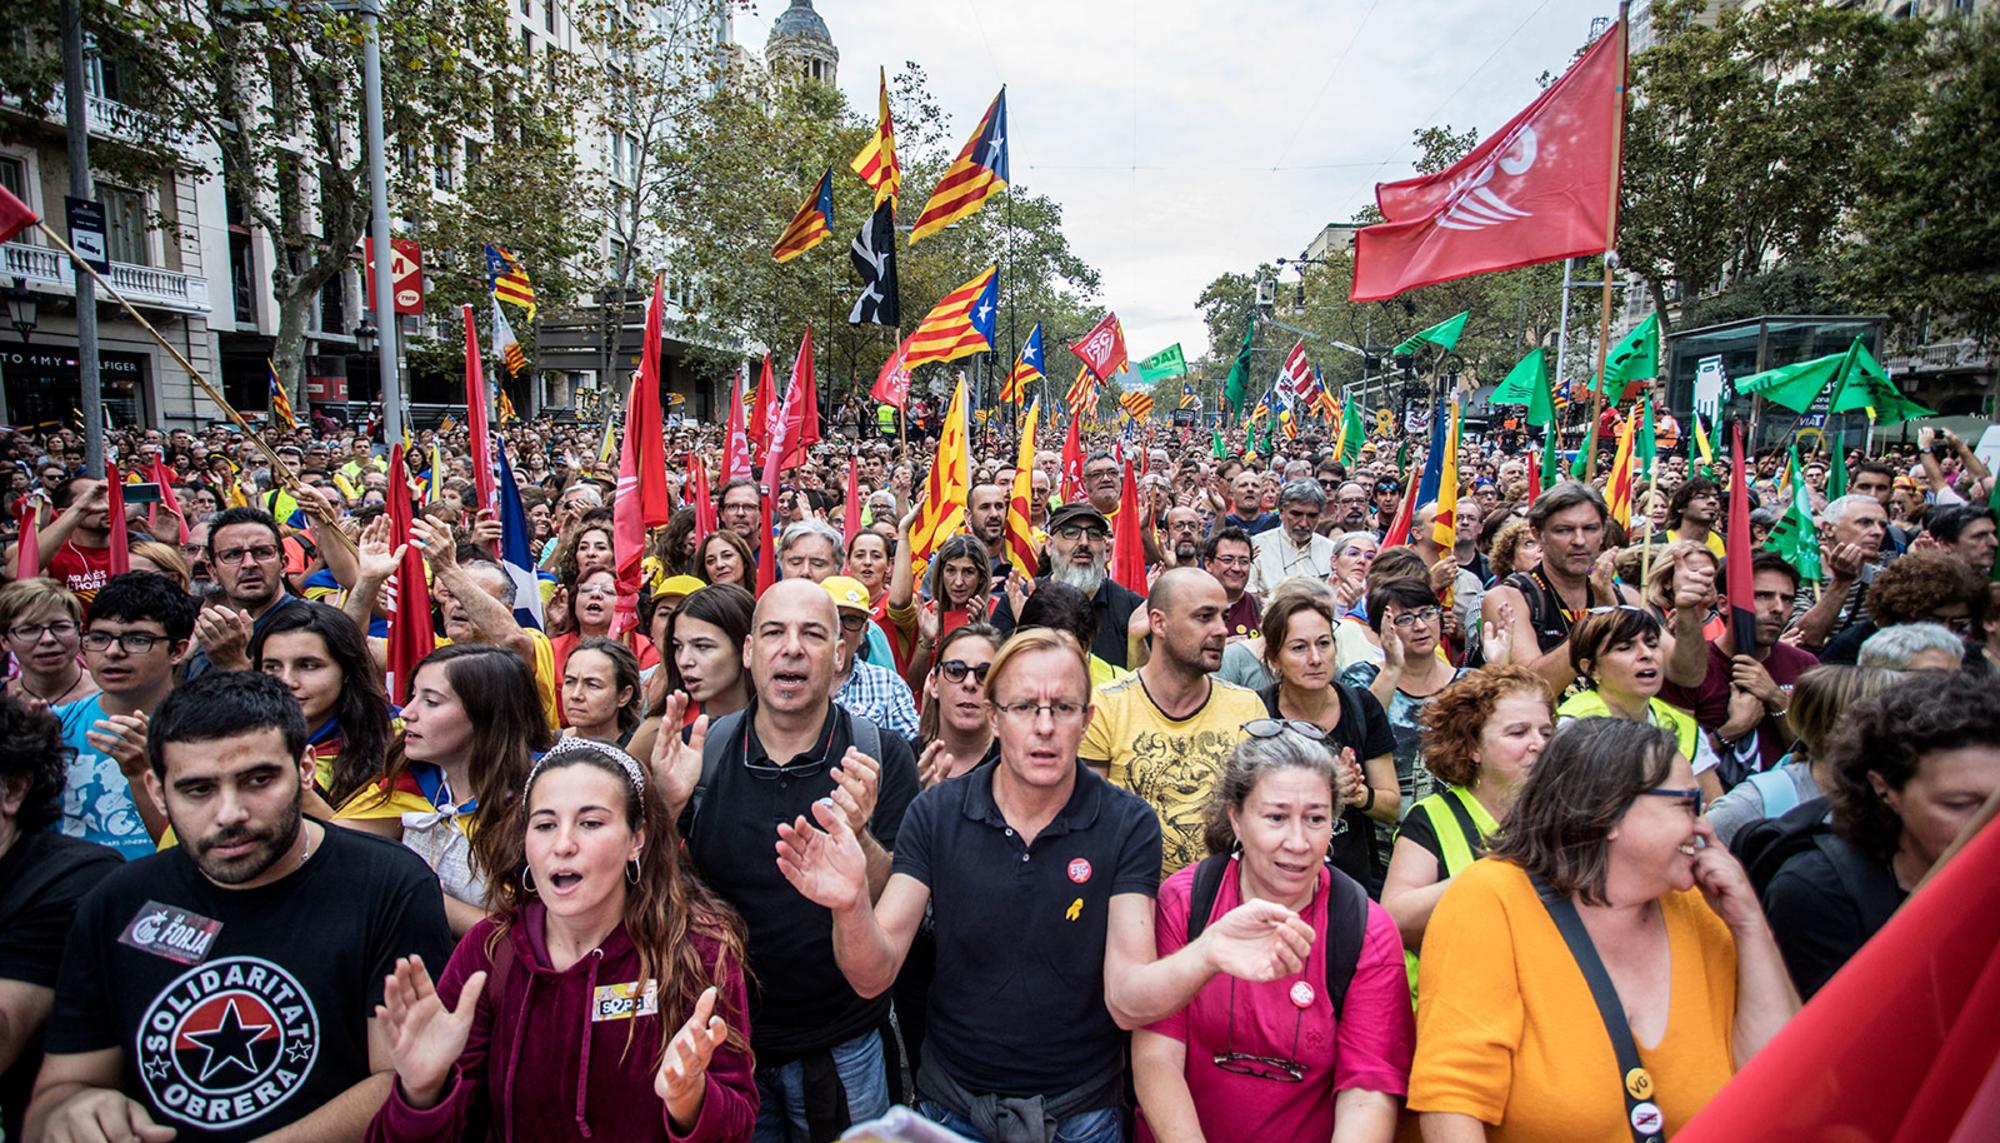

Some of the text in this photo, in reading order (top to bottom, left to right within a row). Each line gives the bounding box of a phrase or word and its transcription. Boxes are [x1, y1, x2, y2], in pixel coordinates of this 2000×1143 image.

[98, 361, 137, 371] LFIGER
[158, 922, 212, 955] FORJA
[146, 964, 310, 1053] SOLIDARITAT
[163, 1067, 299, 1121] OBRERA
[1630, 1075, 1648, 1094] VG
